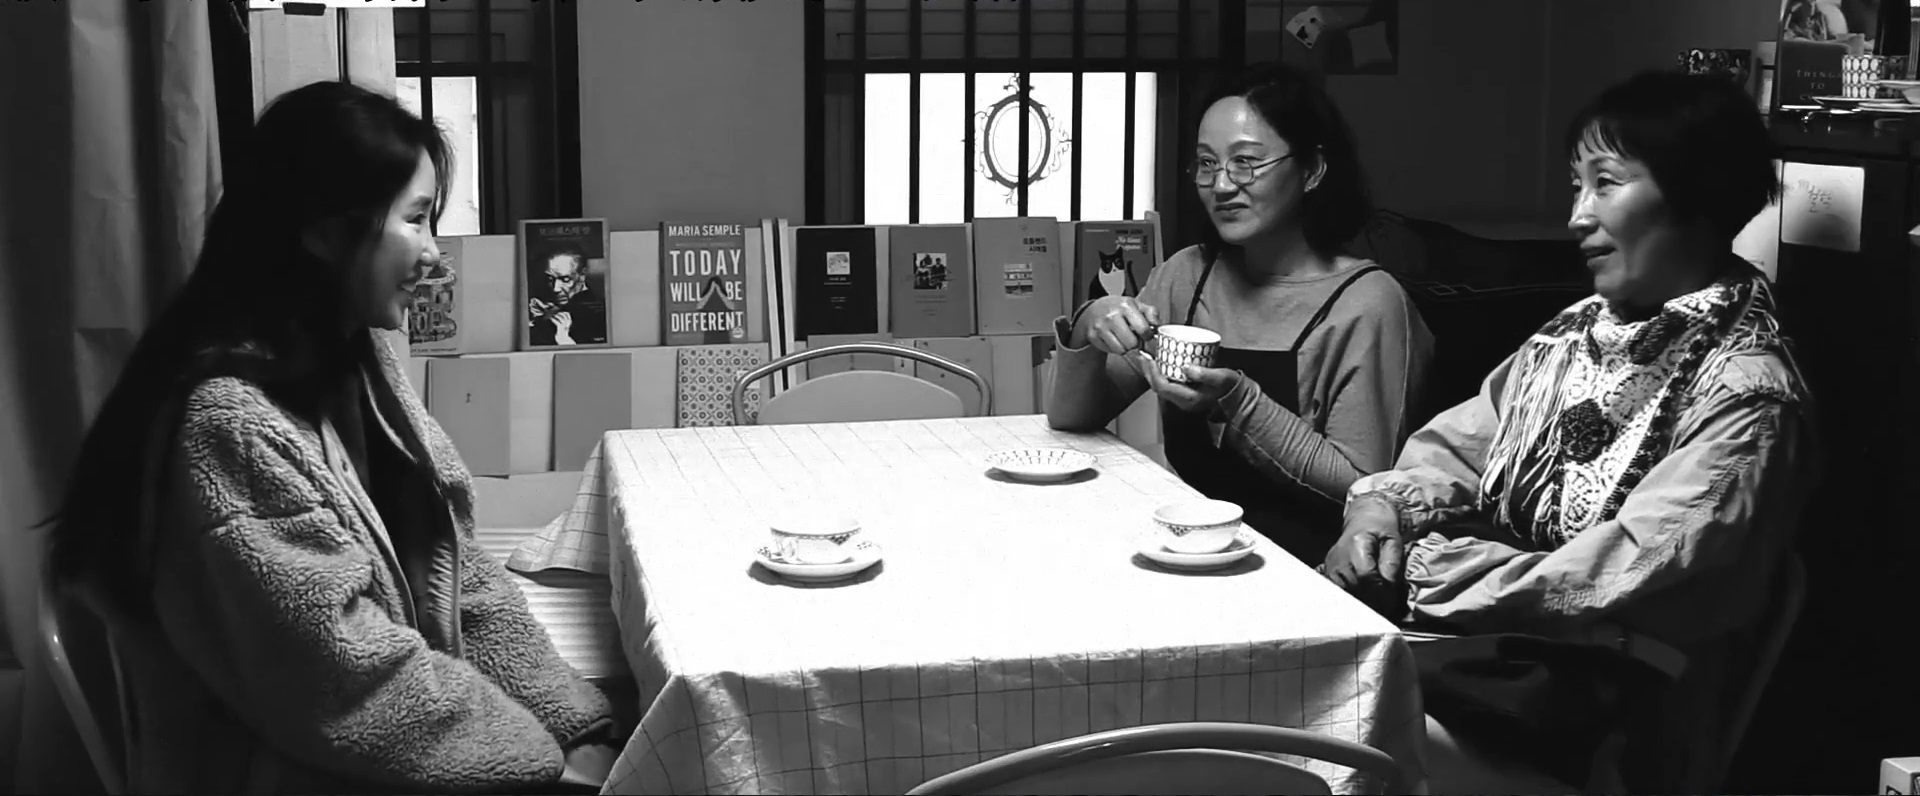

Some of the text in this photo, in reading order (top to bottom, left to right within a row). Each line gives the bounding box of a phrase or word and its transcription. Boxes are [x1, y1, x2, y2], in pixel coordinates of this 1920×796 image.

[1810, 82, 1825, 90] TO
[668, 224, 741, 237] MARIA SEMPLE
[669, 249, 741, 276] TODAY
[670, 281, 743, 302] WILL BE
[671, 311, 744, 332] DIFFERENT
